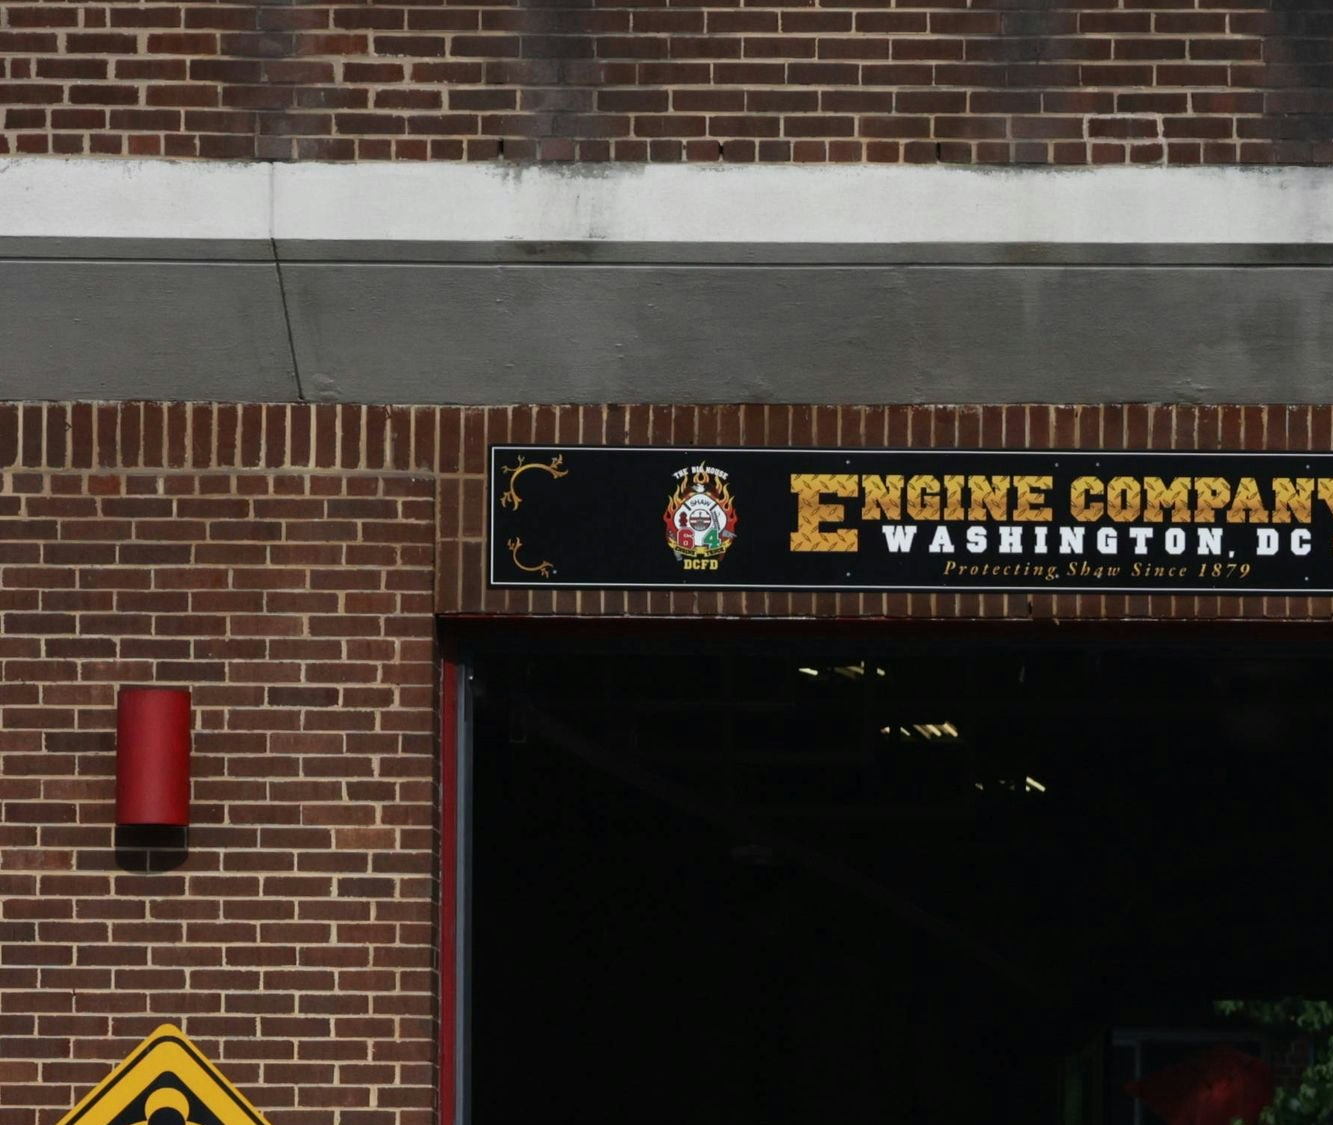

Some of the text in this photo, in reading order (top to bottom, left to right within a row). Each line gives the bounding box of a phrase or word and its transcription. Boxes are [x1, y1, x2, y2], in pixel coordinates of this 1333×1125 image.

[672, 467, 688, 480] THE
[705, 466, 729, 480] HOUSE
[790, 474, 1053, 552] ENGINE
[677, 529, 722, 550] 6 4
[882, 525, 1311, 558] WASHINGTON, DC
[683, 559, 719, 570] DCFD
[943, 560, 1251, 581] Protecting Shaw Since 1879
